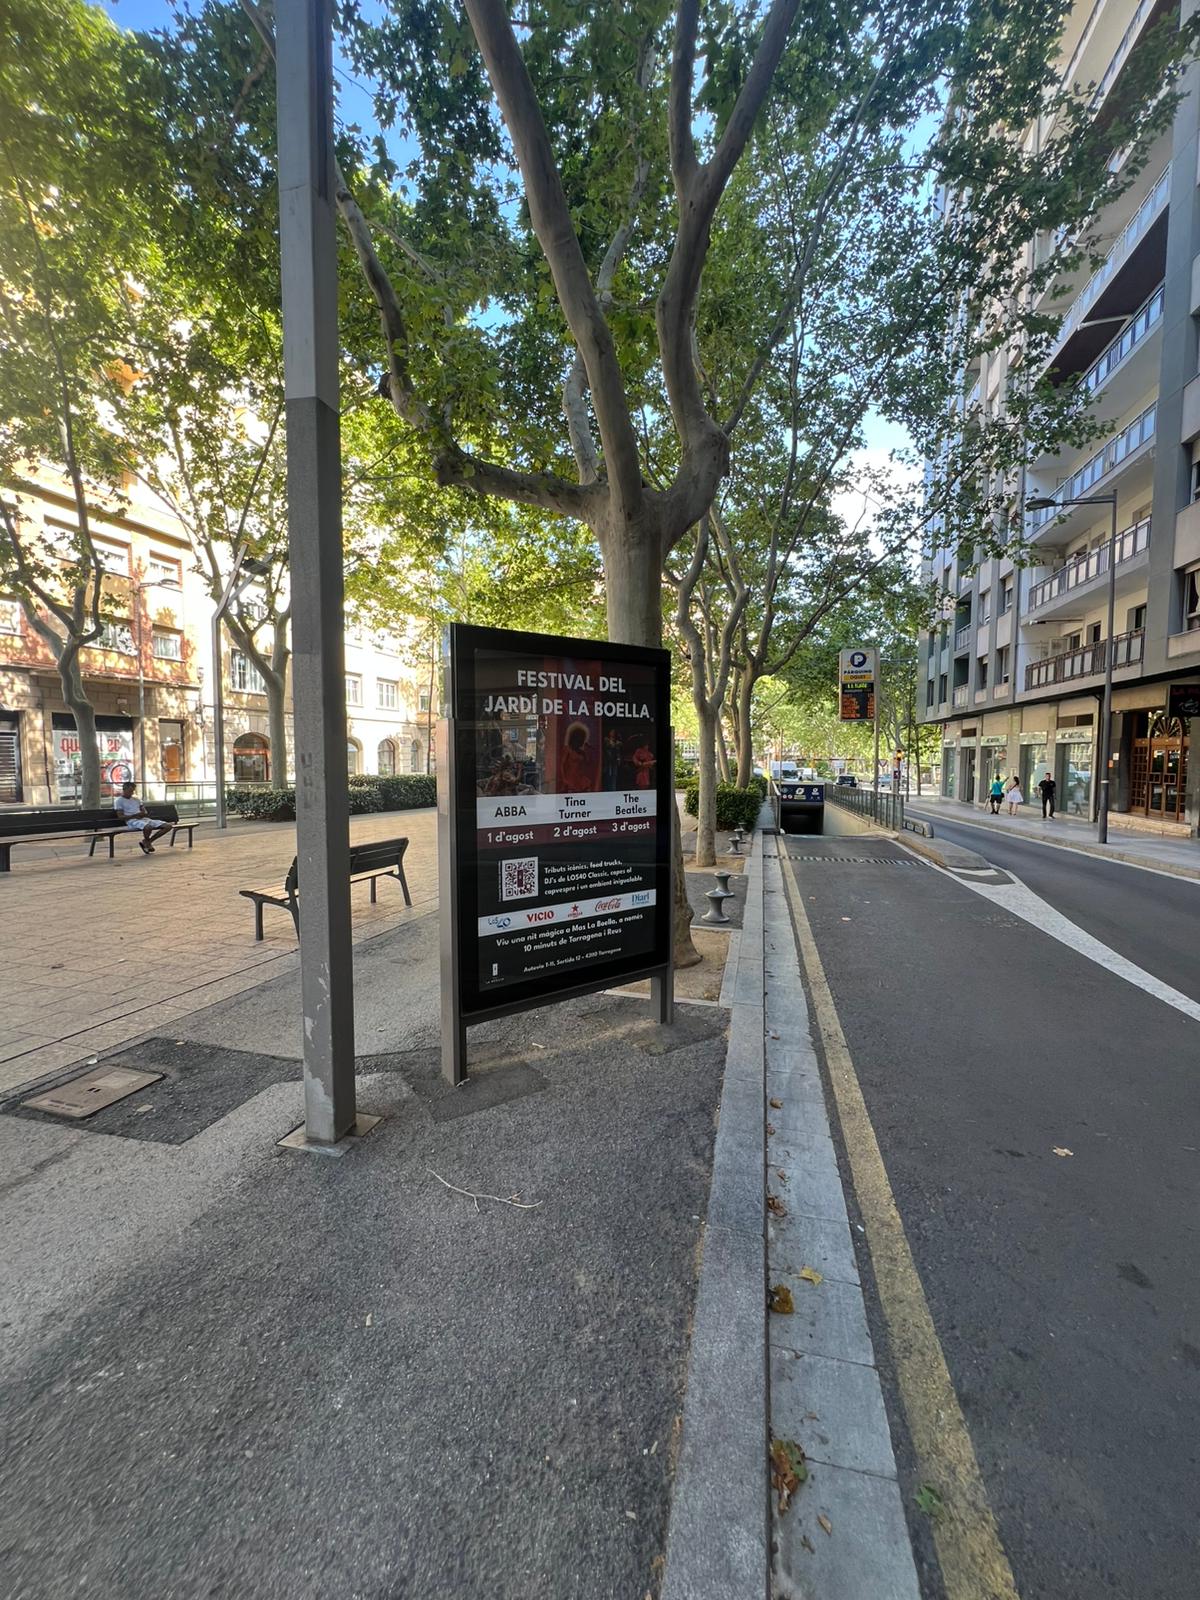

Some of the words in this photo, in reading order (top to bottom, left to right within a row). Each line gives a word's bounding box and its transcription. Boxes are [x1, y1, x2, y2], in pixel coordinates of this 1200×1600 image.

[517, 669, 594, 692] FESTIVAL
[599, 677, 626, 693] DEL
[485, 693, 538, 714] JARDÍ
[542, 698, 563, 715] DE
[568, 699, 589, 716] LA
[594, 702, 650, 719] BOELLA
[564, 796, 586, 807] Tina
[623, 793, 639, 804] The
[494, 805, 527, 818] ABBA
[558, 808, 592, 820] Turner
[615, 805, 647, 816] Beatles
[553, 827, 561, 838] 2
[564, 825, 597, 839] d'agost
[611, 822, 618, 833] 3
[620, 821, 650, 834] d'agost
[487, 833, 493, 843] 1
[495, 831, 534, 846] d'agost
[544, 864, 566, 874] Tributs
[590, 860, 603, 868] food
[558, 875, 566, 883] de
[566, 872, 587, 882] LOS40
[544, 885, 576, 896] capvespre
[588, 880, 612, 889] ambient
[631, 892, 650, 903] Diari
[526, 910, 555, 923] VICIO
[496, 938, 509, 947] Viu
[510, 936, 525, 944] una
[526, 933, 538, 941] nit
[538, 929, 565, 940] màgica
[571, 924, 586, 932] Mas
[596, 917, 618, 928] Boella,
[624, 913, 644, 922] només
[523, 944, 532, 953] 10
[533, 940, 557, 952] minuts
[568, 932, 603, 943] Tarragona
[607, 927, 622, 936] Reus
